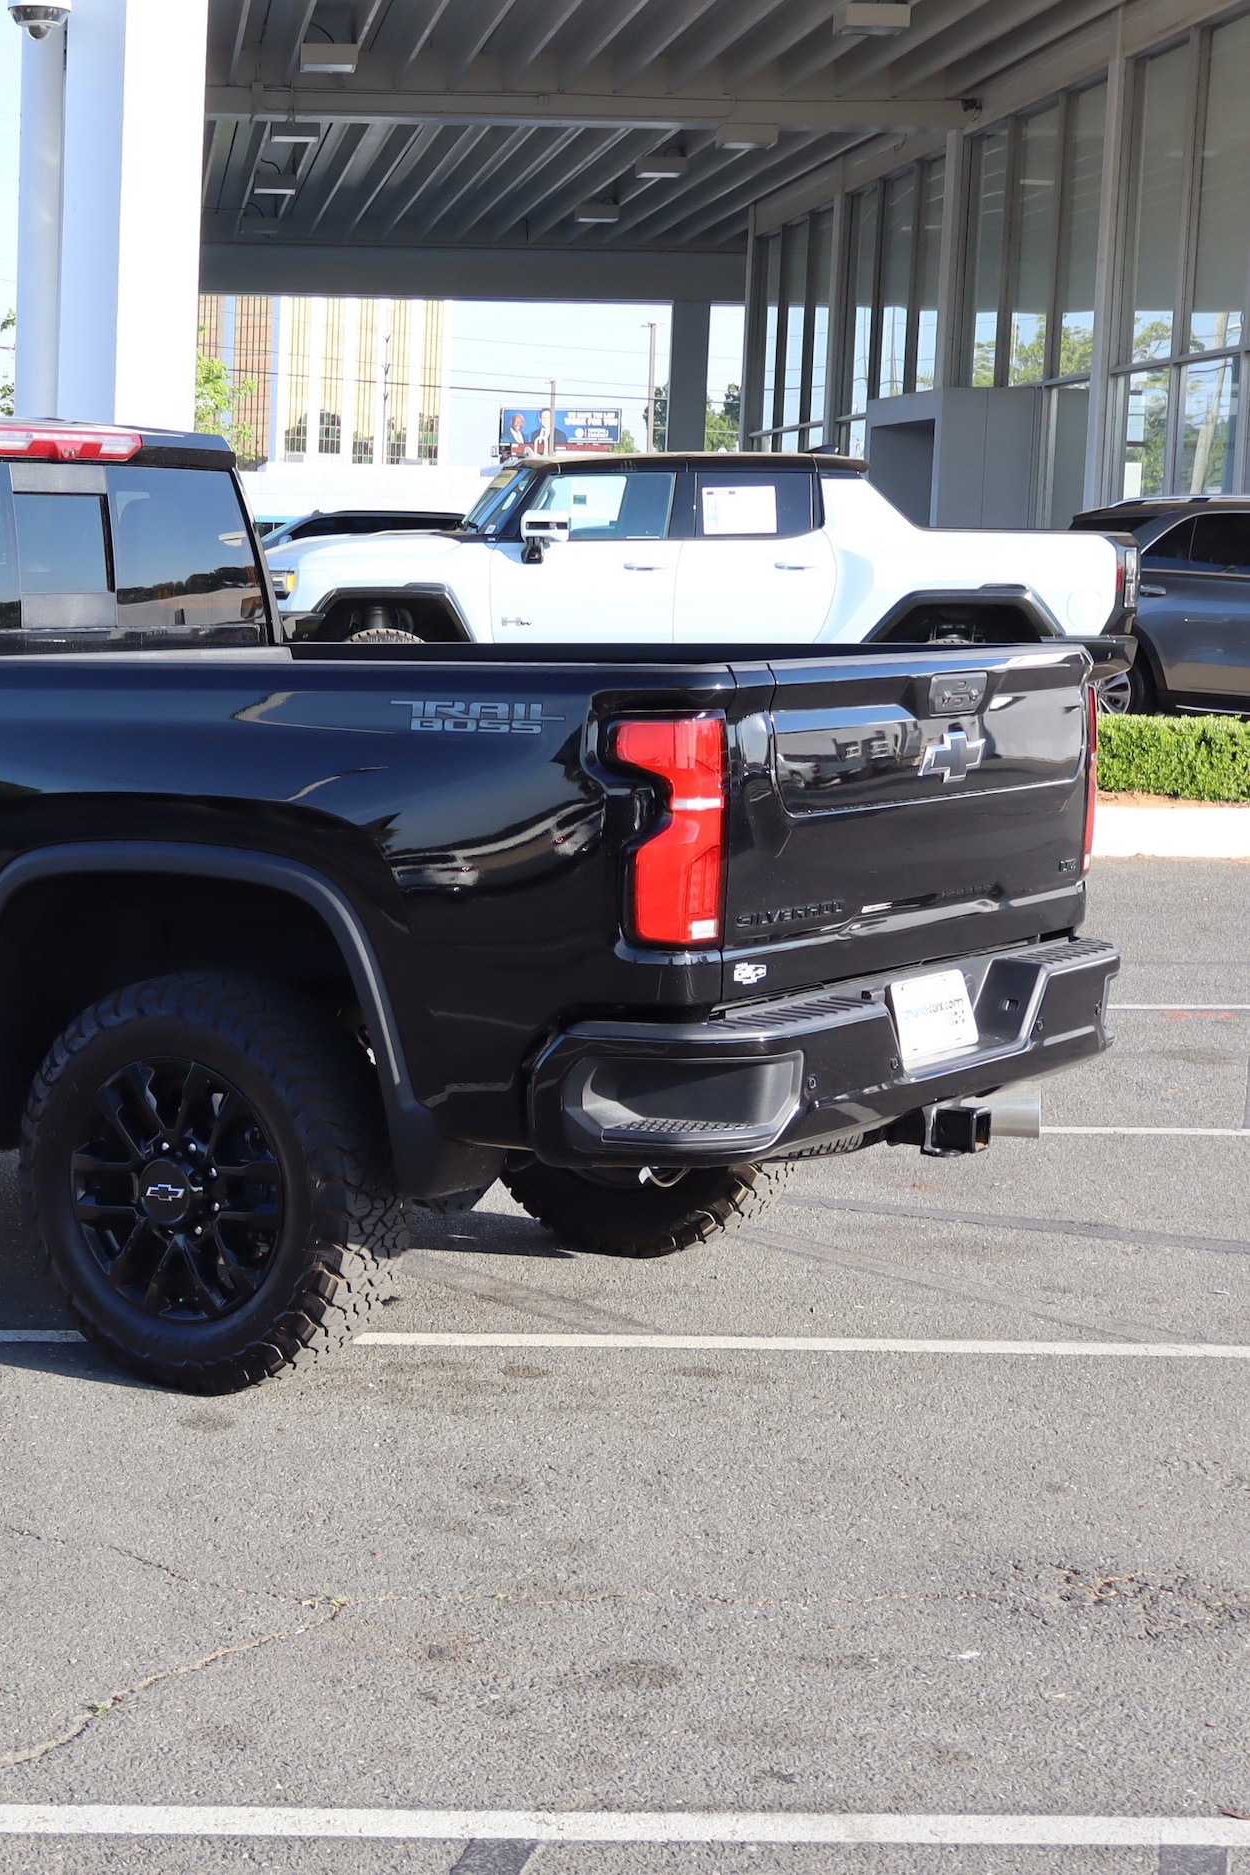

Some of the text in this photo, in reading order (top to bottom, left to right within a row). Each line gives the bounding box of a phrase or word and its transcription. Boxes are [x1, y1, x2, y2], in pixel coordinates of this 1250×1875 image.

[390, 700, 565, 721] TRAIL
[410, 717, 543, 735] BOSS
[736, 900, 846, 929] SILVERADO
